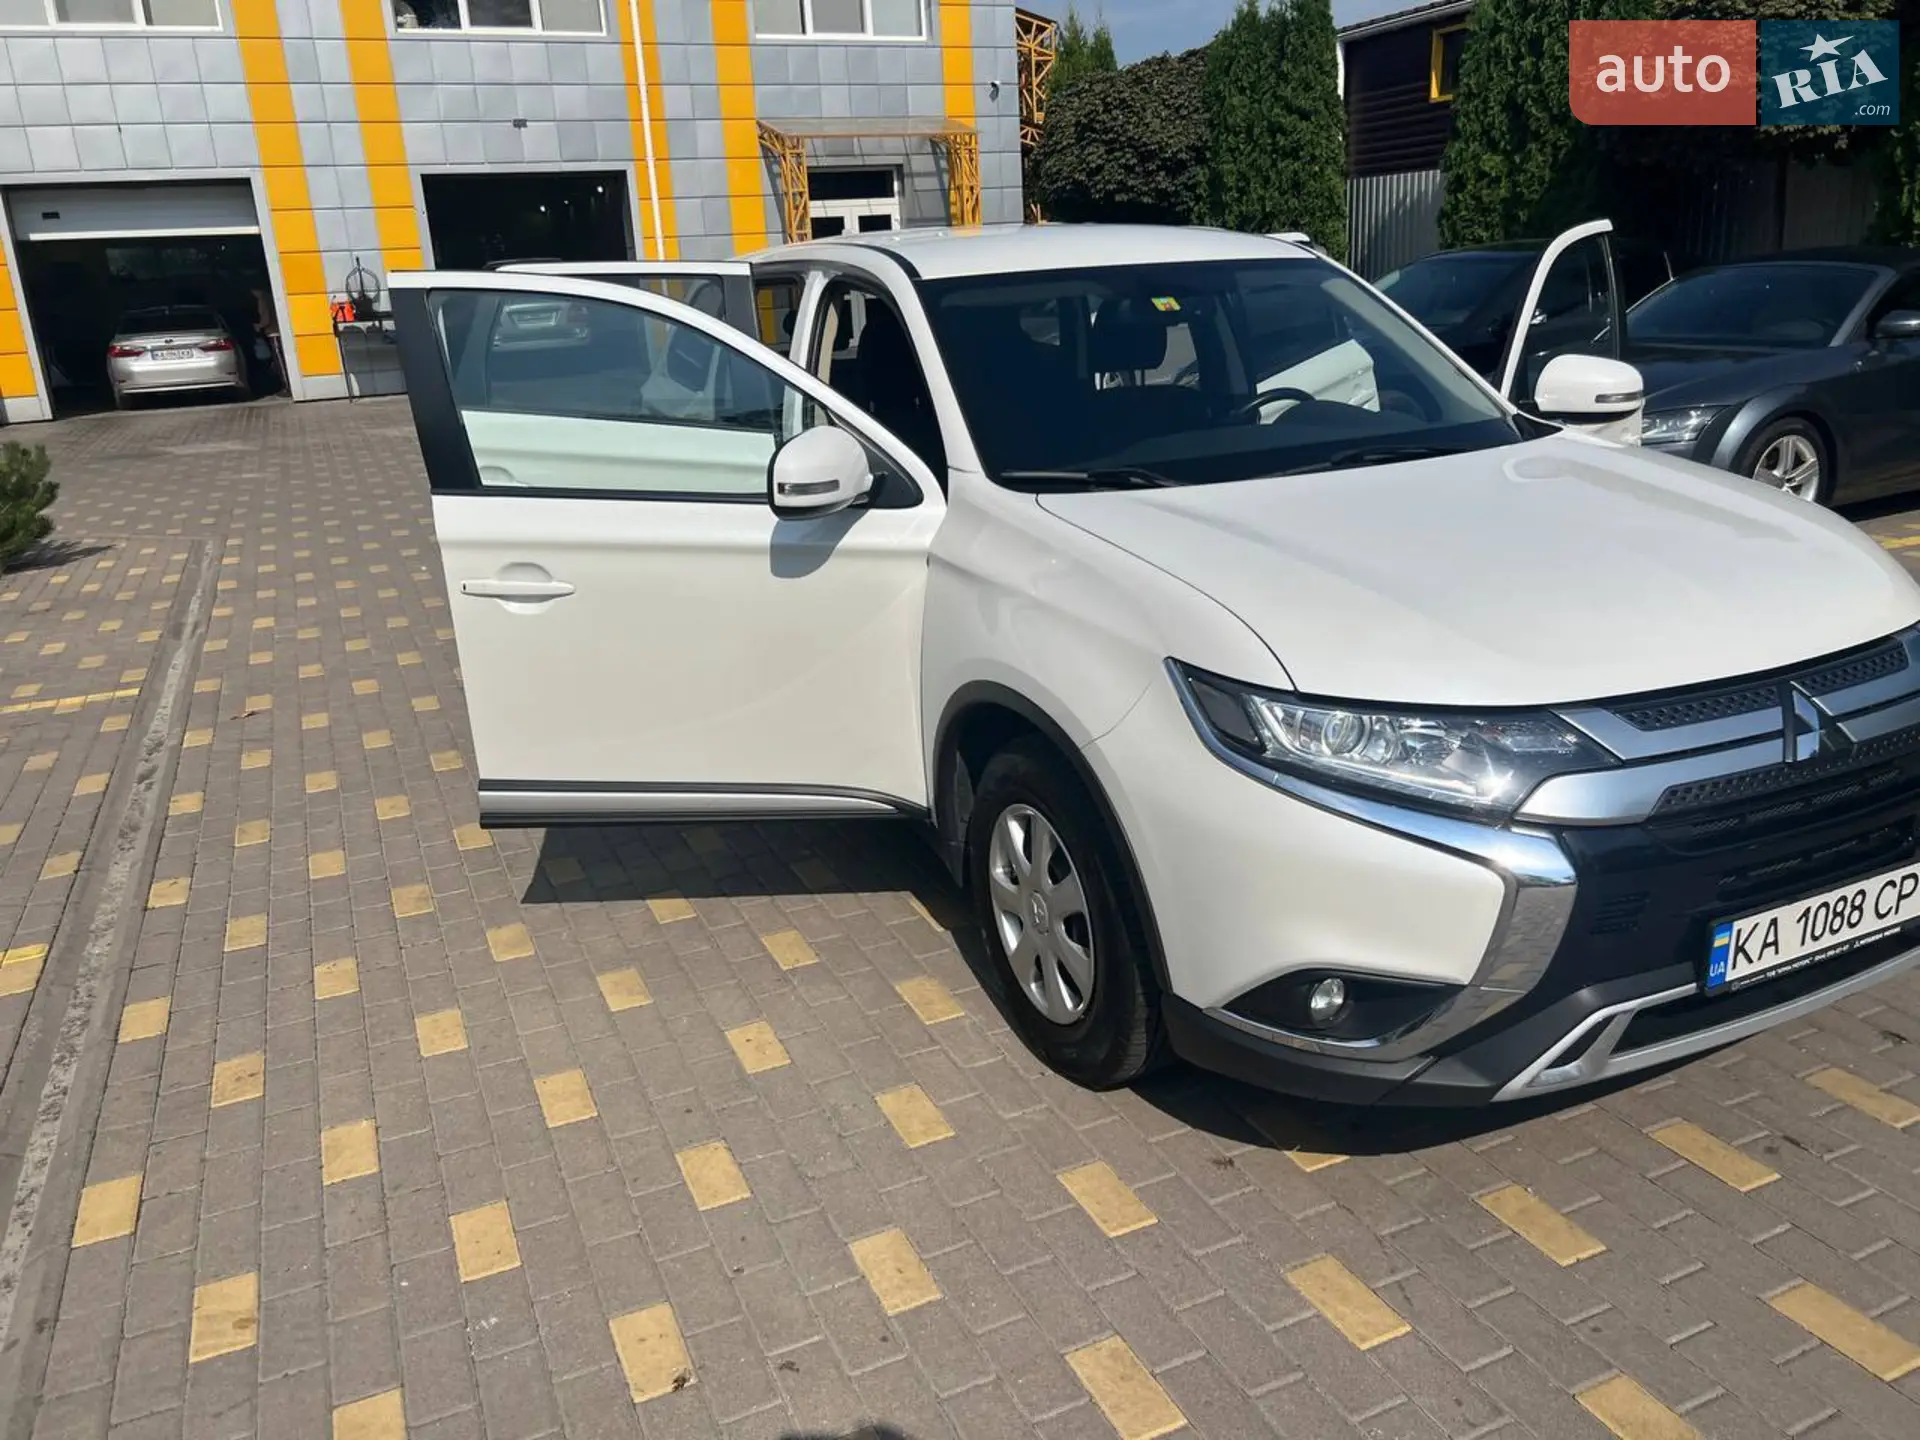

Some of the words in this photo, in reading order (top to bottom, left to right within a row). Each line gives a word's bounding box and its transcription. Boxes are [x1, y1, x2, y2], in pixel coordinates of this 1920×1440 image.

[1732, 917, 1780, 970] KA
[1796, 889, 1867, 946] 1088
[1873, 872, 1919, 920] CP
[1709, 961, 1726, 977] UA
